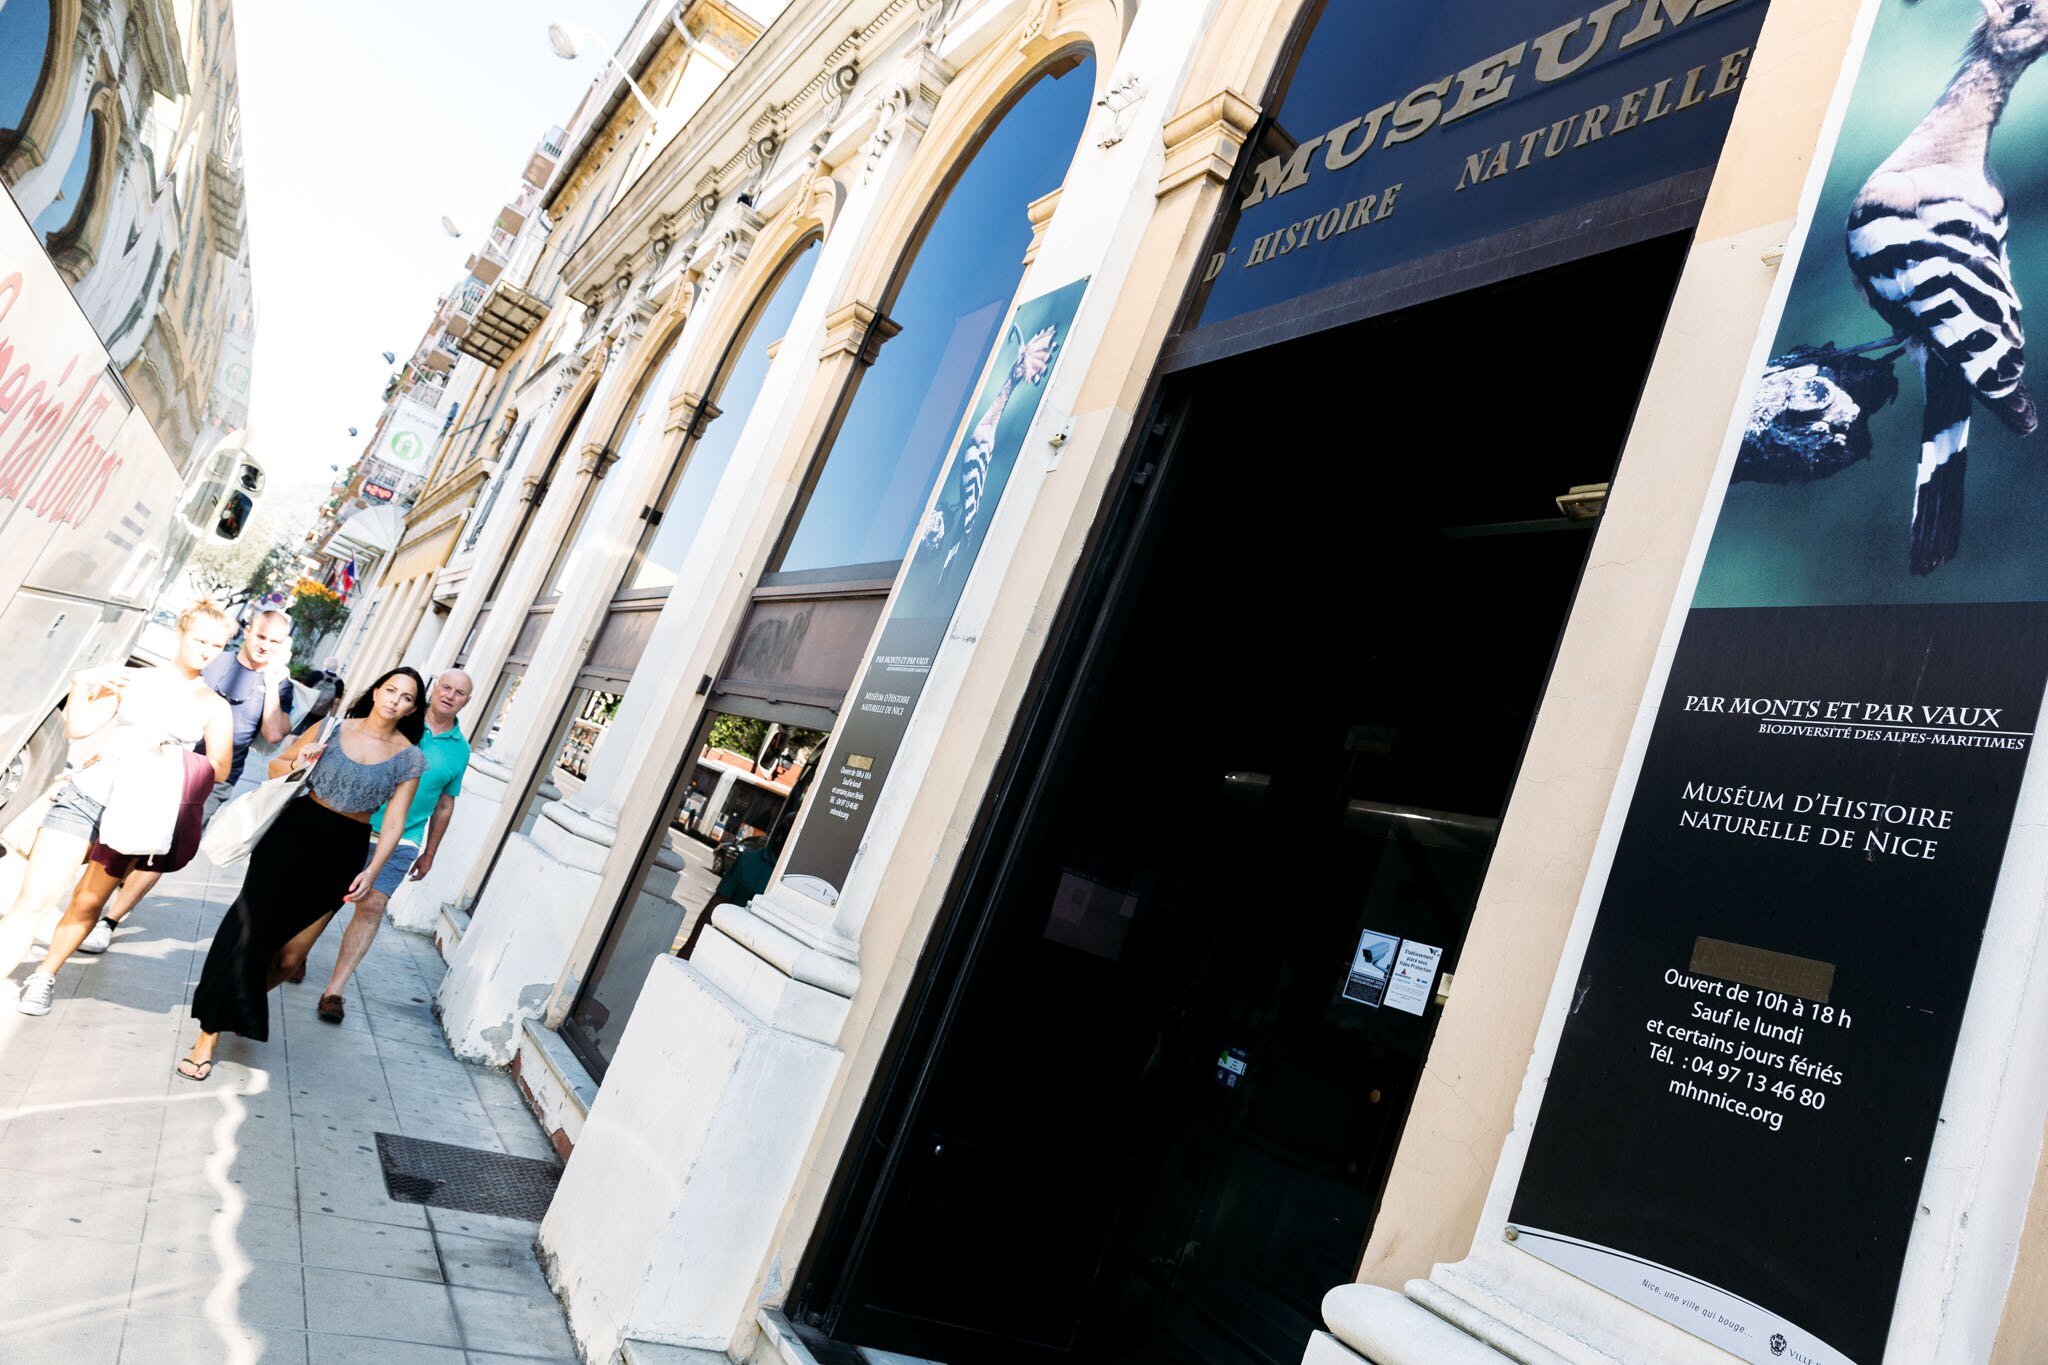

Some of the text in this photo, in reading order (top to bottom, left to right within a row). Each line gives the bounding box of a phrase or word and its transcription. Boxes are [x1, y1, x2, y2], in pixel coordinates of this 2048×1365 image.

[1244, 183, 1402, 269] HISTOIRE
[1454, 47, 1750, 191] NATURELLE
[25, 387, 124, 530] Tours
[1683, 695, 2003, 728] PAR MONTS ET PAR VAUX
[1758, 723, 2025, 751] BIODIVERSITÉ DES ALPES-MARITIMES
[1664, 968, 1852, 1029] Ouvert de 10h à 18 h
[1691, 1001, 1804, 1045] Sauf le lundi
[1646, 1019, 1843, 1086] et certains jours fériés
[1648, 1042, 1674, 1065] Tél.
[1717, 1063, 1741, 1083] 97
[1746, 1072, 1767, 1092] 13
[1771, 1080, 1796, 1101] 46
[1799, 1088, 1826, 1110] 80
[1668, 1079, 1784, 1131] mhnnice.org
[1641, 1278, 1661, 1296] Nice,
[1664, 1290, 1680, 1303] une
[1682, 1297, 1701, 1313] ville
[1702, 1307, 1717, 1320] qui
